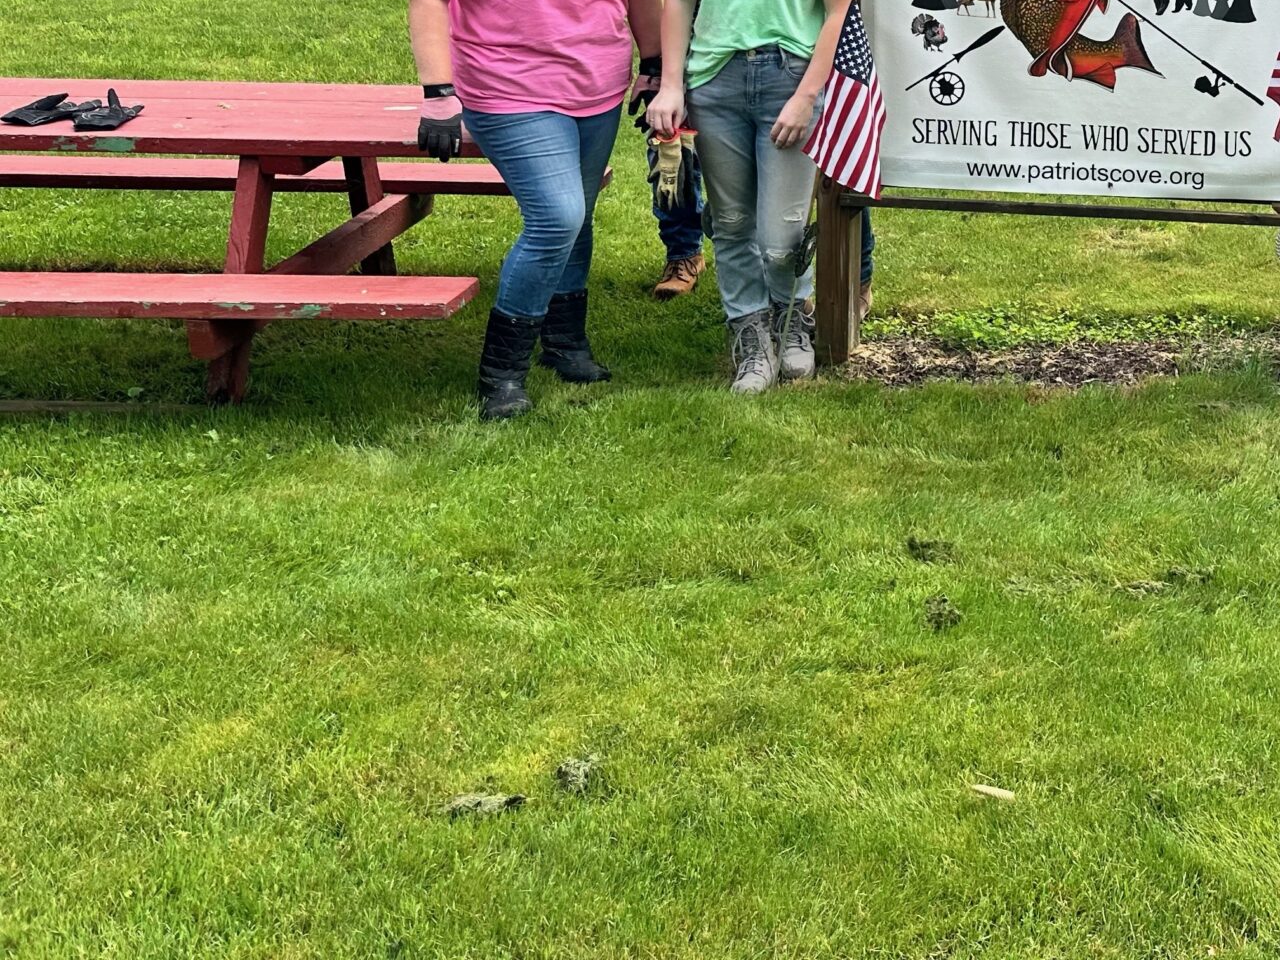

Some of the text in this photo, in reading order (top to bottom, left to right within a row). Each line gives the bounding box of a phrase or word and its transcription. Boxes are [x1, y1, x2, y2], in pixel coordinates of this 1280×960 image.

[912, 117, 1252, 157] SERVING THOSE WHO SERVED US
[967, 160, 1205, 190] www.patriotscove.org
